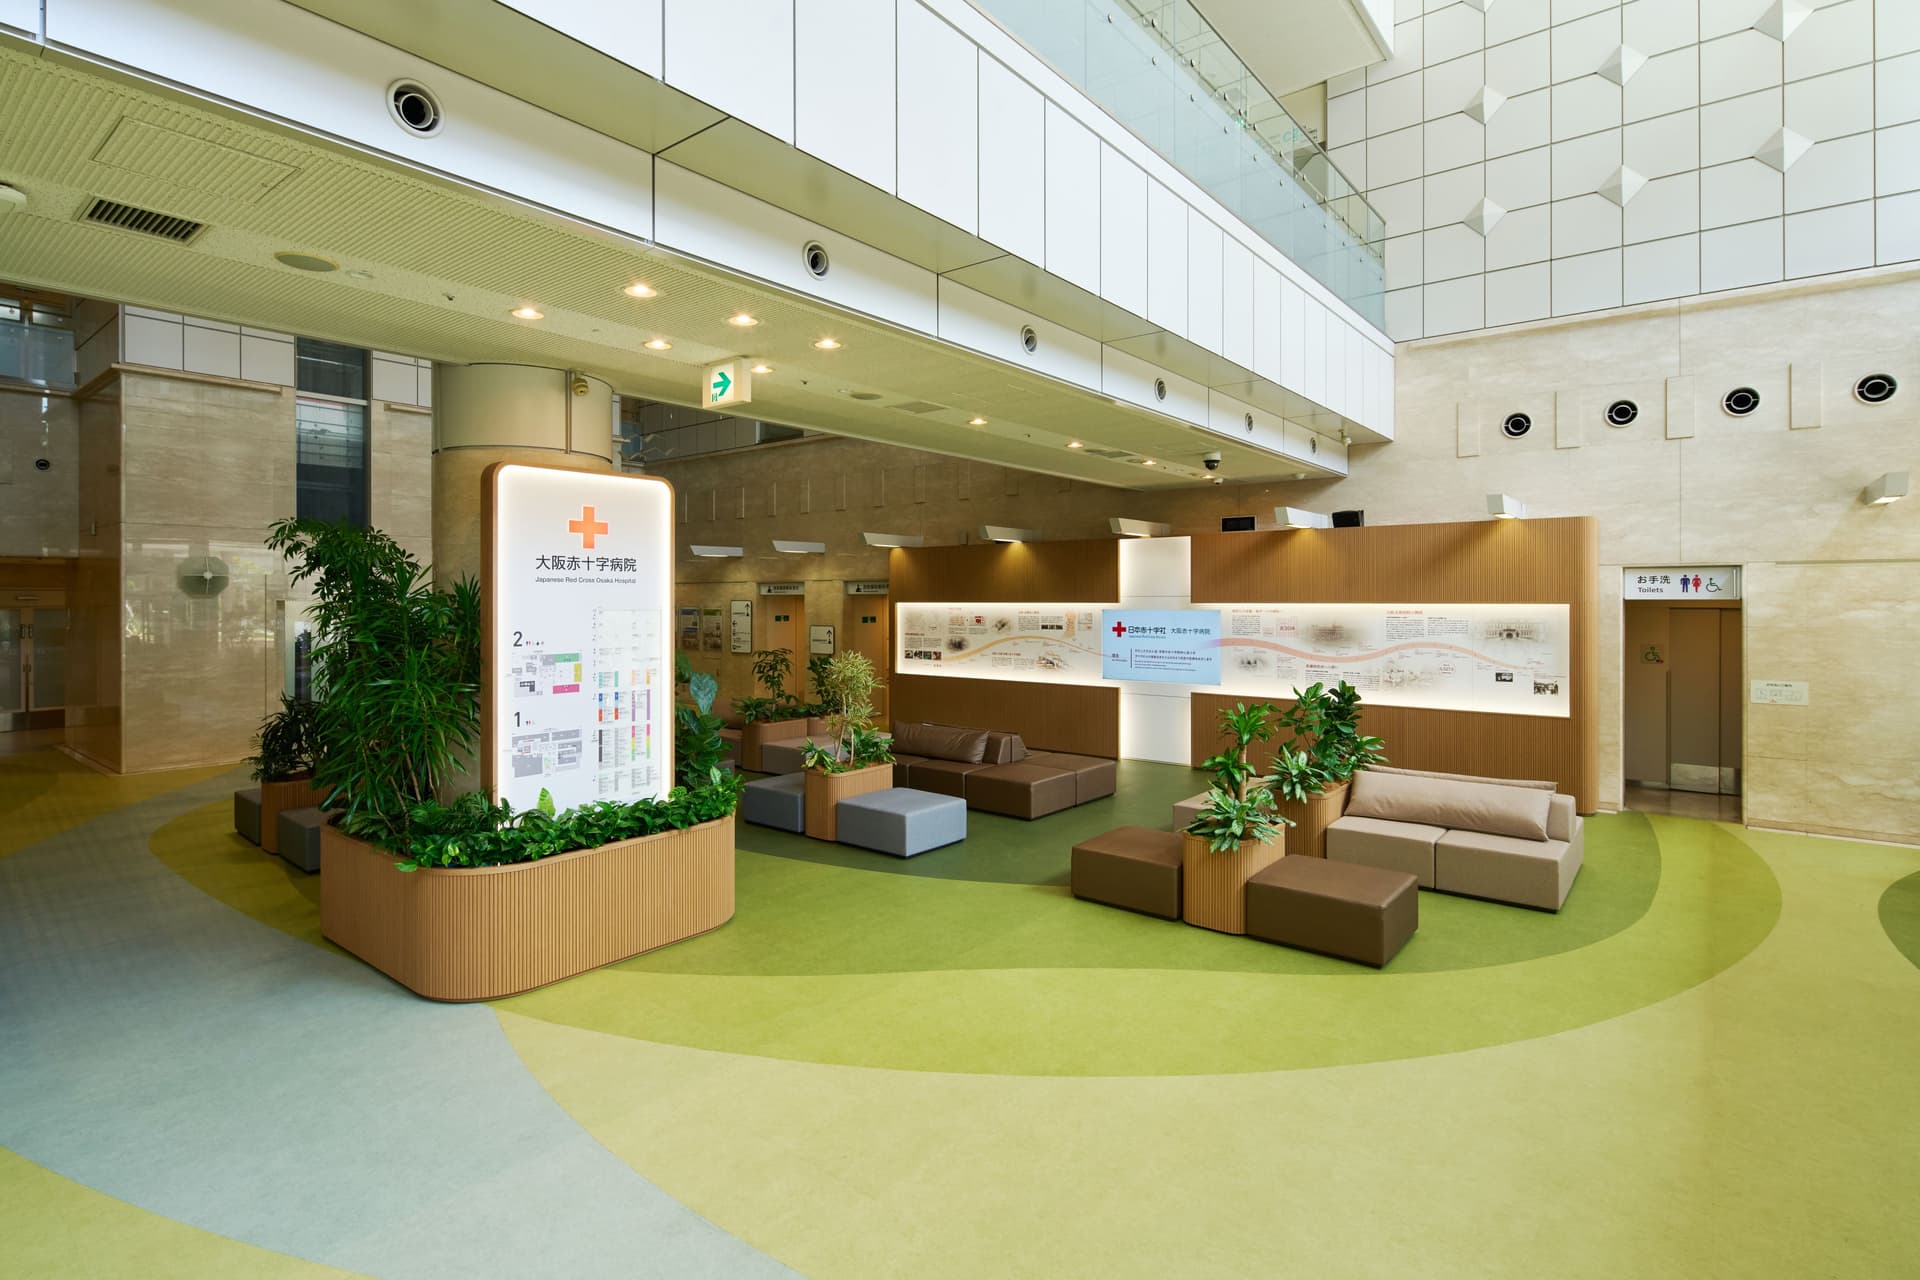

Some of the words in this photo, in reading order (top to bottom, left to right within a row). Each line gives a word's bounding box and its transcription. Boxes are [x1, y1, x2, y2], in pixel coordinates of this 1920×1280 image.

[535, 554, 637, 572] 大阪赤十字病院
[1637, 575, 1671, 584] お手洗
[513, 631, 523, 648] 2
[514, 711, 521, 728] 1
